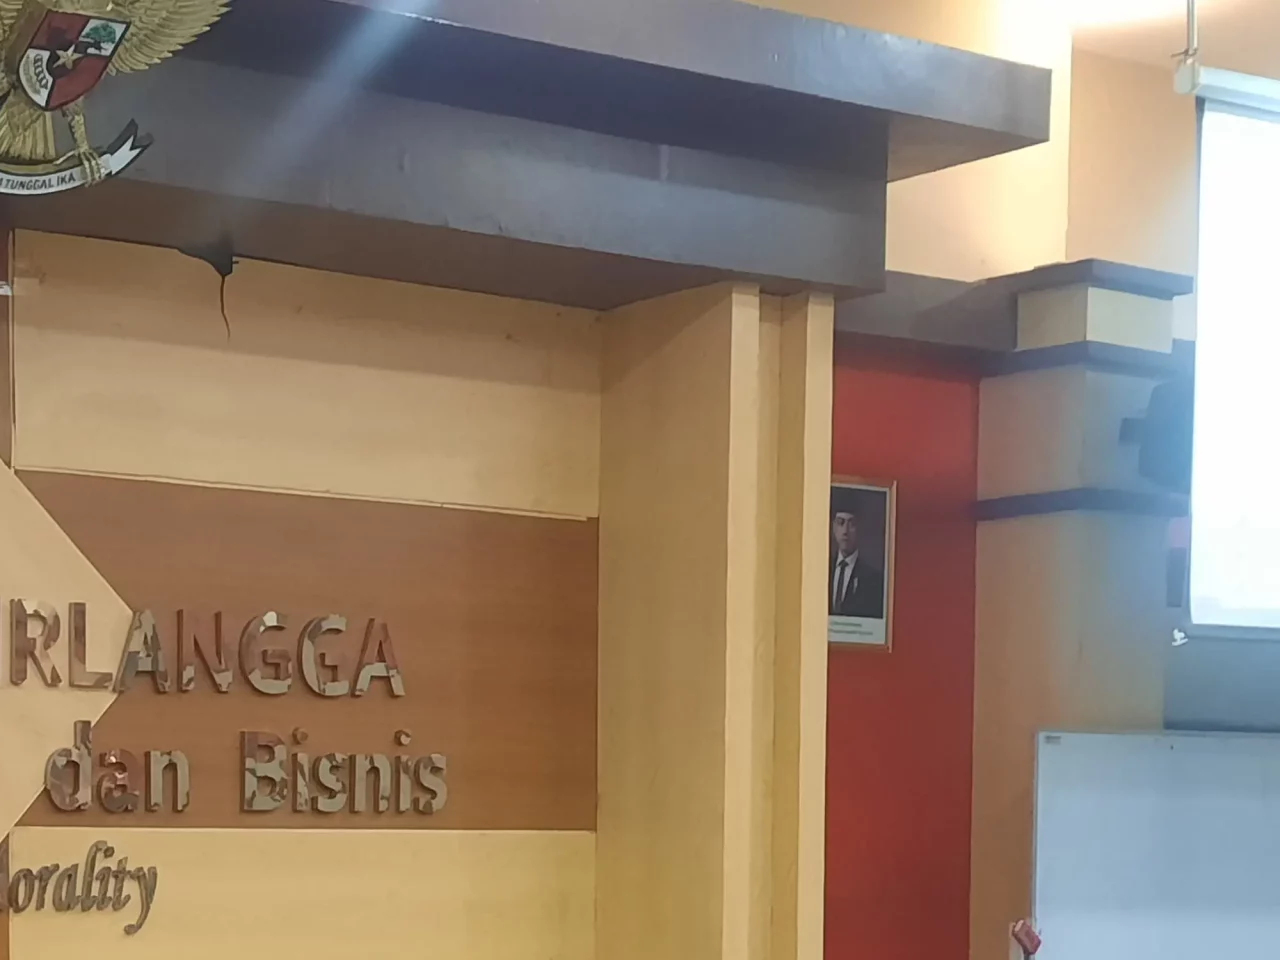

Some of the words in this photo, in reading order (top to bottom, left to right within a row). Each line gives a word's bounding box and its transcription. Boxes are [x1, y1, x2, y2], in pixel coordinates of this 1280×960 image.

[3, 176, 54, 190] TUNGGAL
[57, 172, 76, 186] IKA
[43, 720, 192, 815] dan
[238, 728, 448, 815] Bisnis
